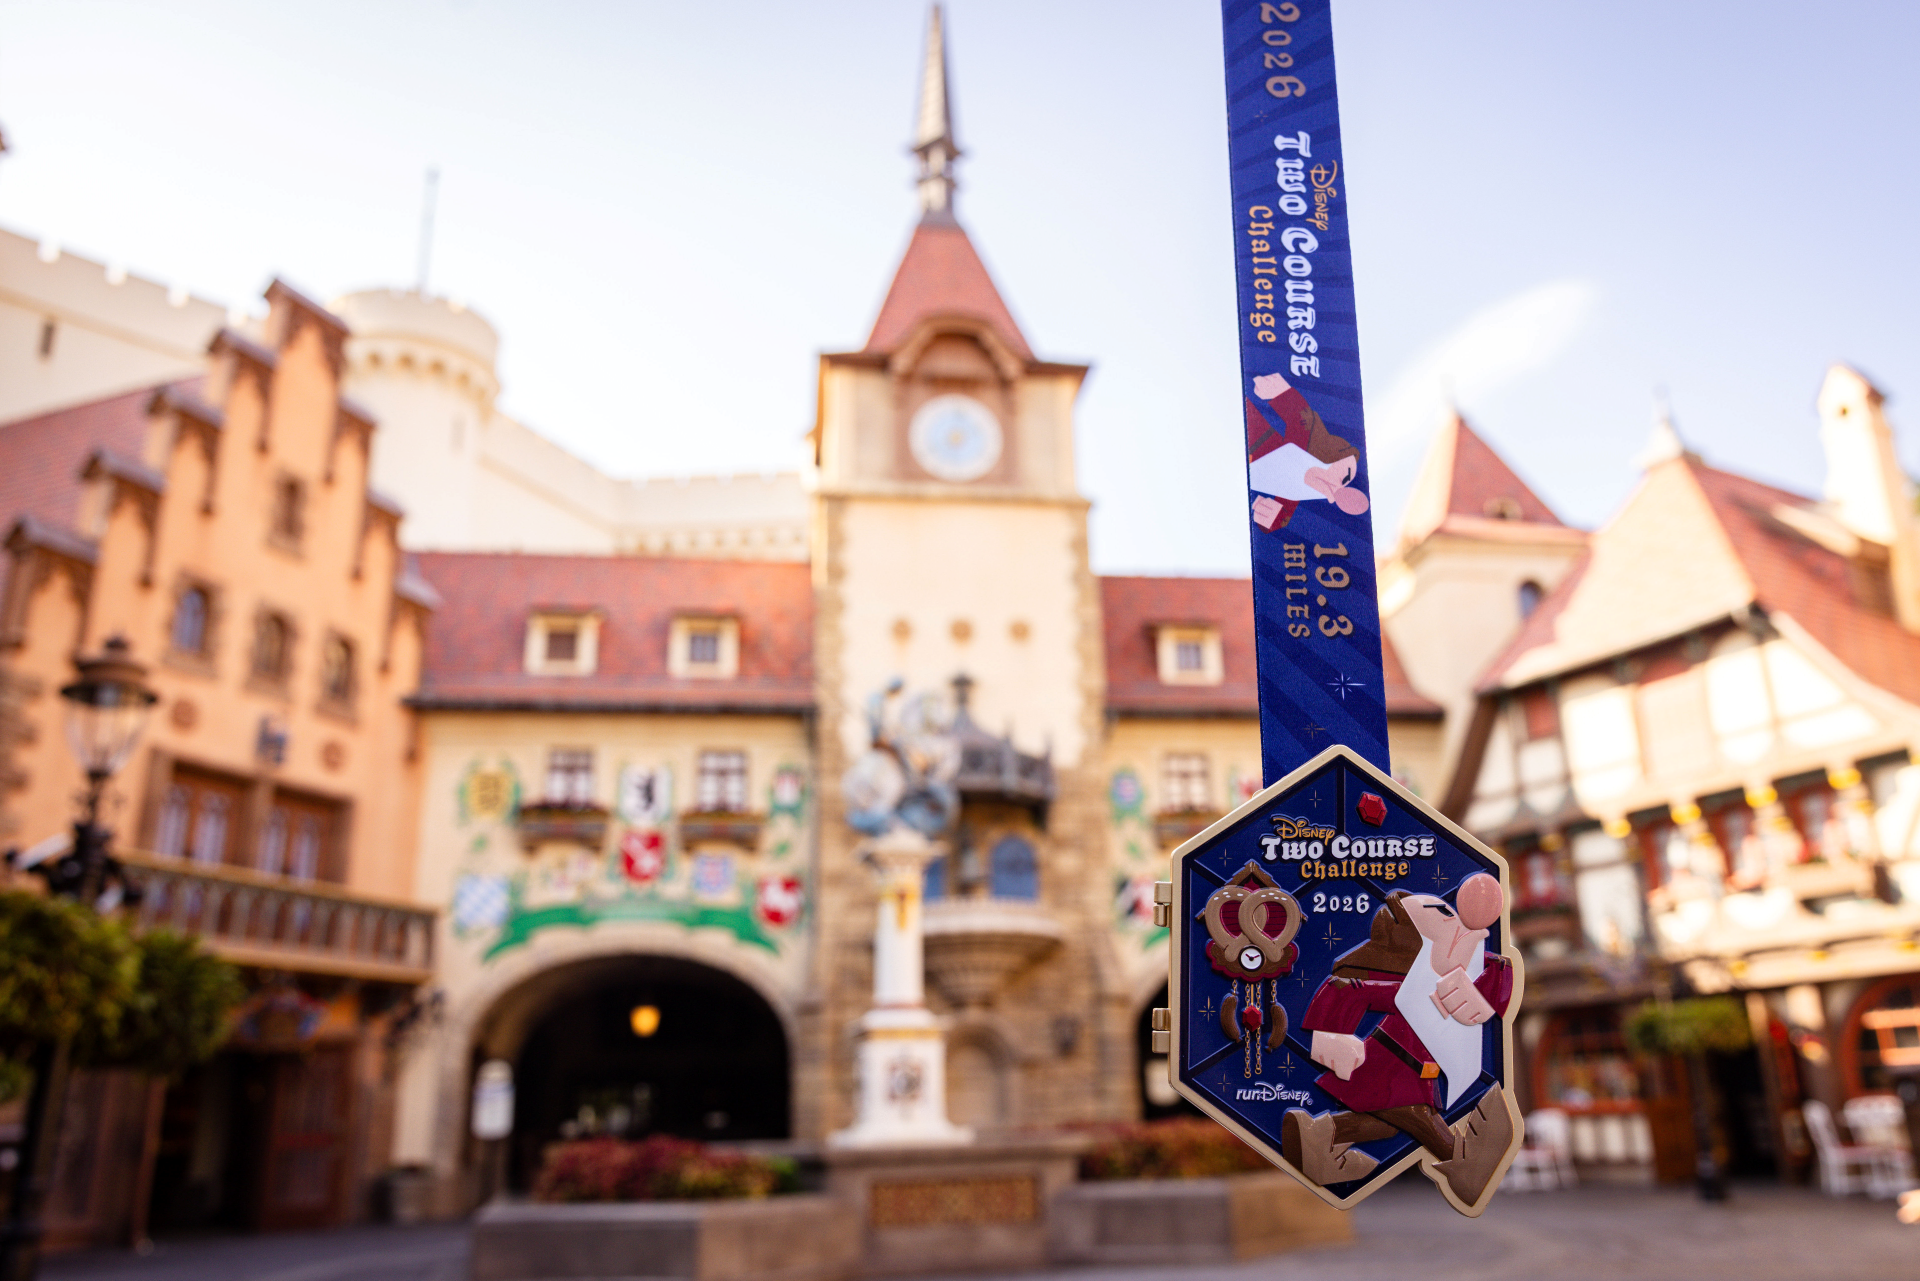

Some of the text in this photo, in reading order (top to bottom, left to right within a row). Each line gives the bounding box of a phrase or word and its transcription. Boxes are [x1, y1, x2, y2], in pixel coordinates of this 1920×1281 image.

[1260, 2, 1306, 98] 2026
[1247, 205, 1278, 343] Challenge
[1283, 543, 1311, 638] MILES
[1313, 542, 1354, 638] 19.3
[1301, 859, 1409, 881] Challenge
[1313, 893, 1370, 914] 2026
